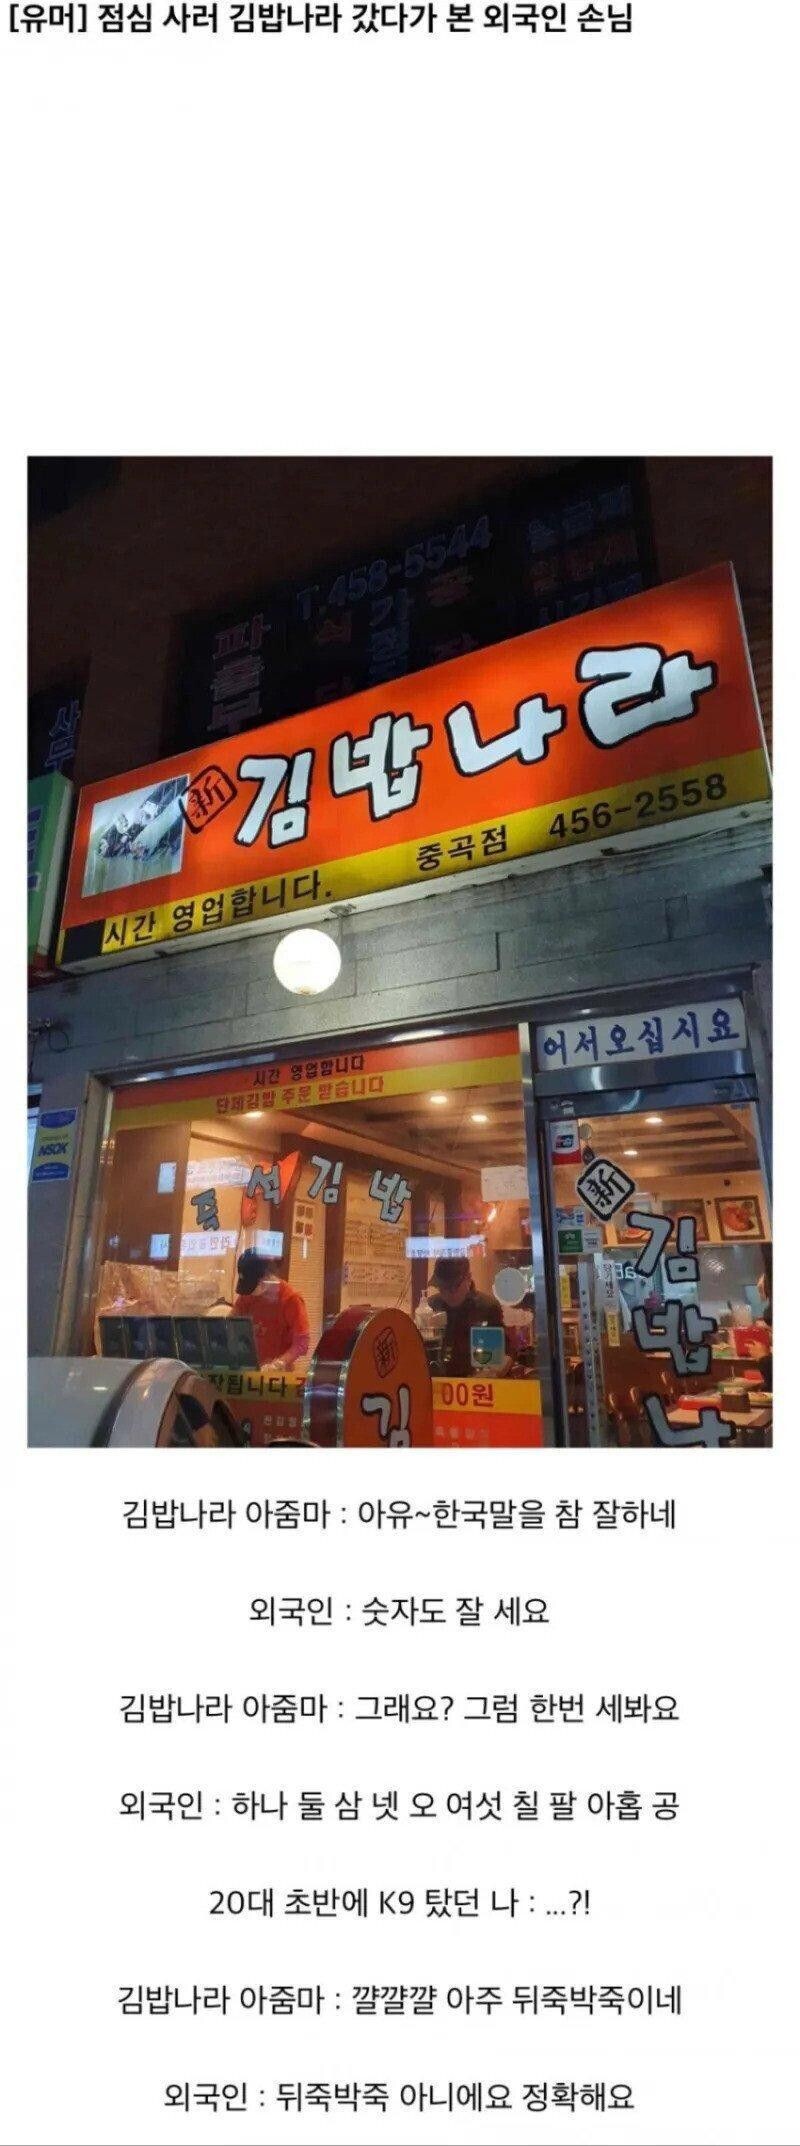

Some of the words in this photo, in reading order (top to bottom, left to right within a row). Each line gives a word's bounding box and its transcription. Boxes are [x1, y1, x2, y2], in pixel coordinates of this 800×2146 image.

[235, 643, 718, 848] 김밥나라
[416, 824, 508, 872] 중곡점
[549, 773, 728, 839] 456-2558
[104, 910, 157, 945] 시간
[171, 870, 334, 934] 영업합니다.
[543, 1008, 741, 1066] 어서오십시요
[253, 1068, 281, 1087] 시간
[291, 1054, 365, 1081] 영업합니다
[282, 1084, 313, 1105] 주문
[317, 1075, 384, 1100] 받습니다
